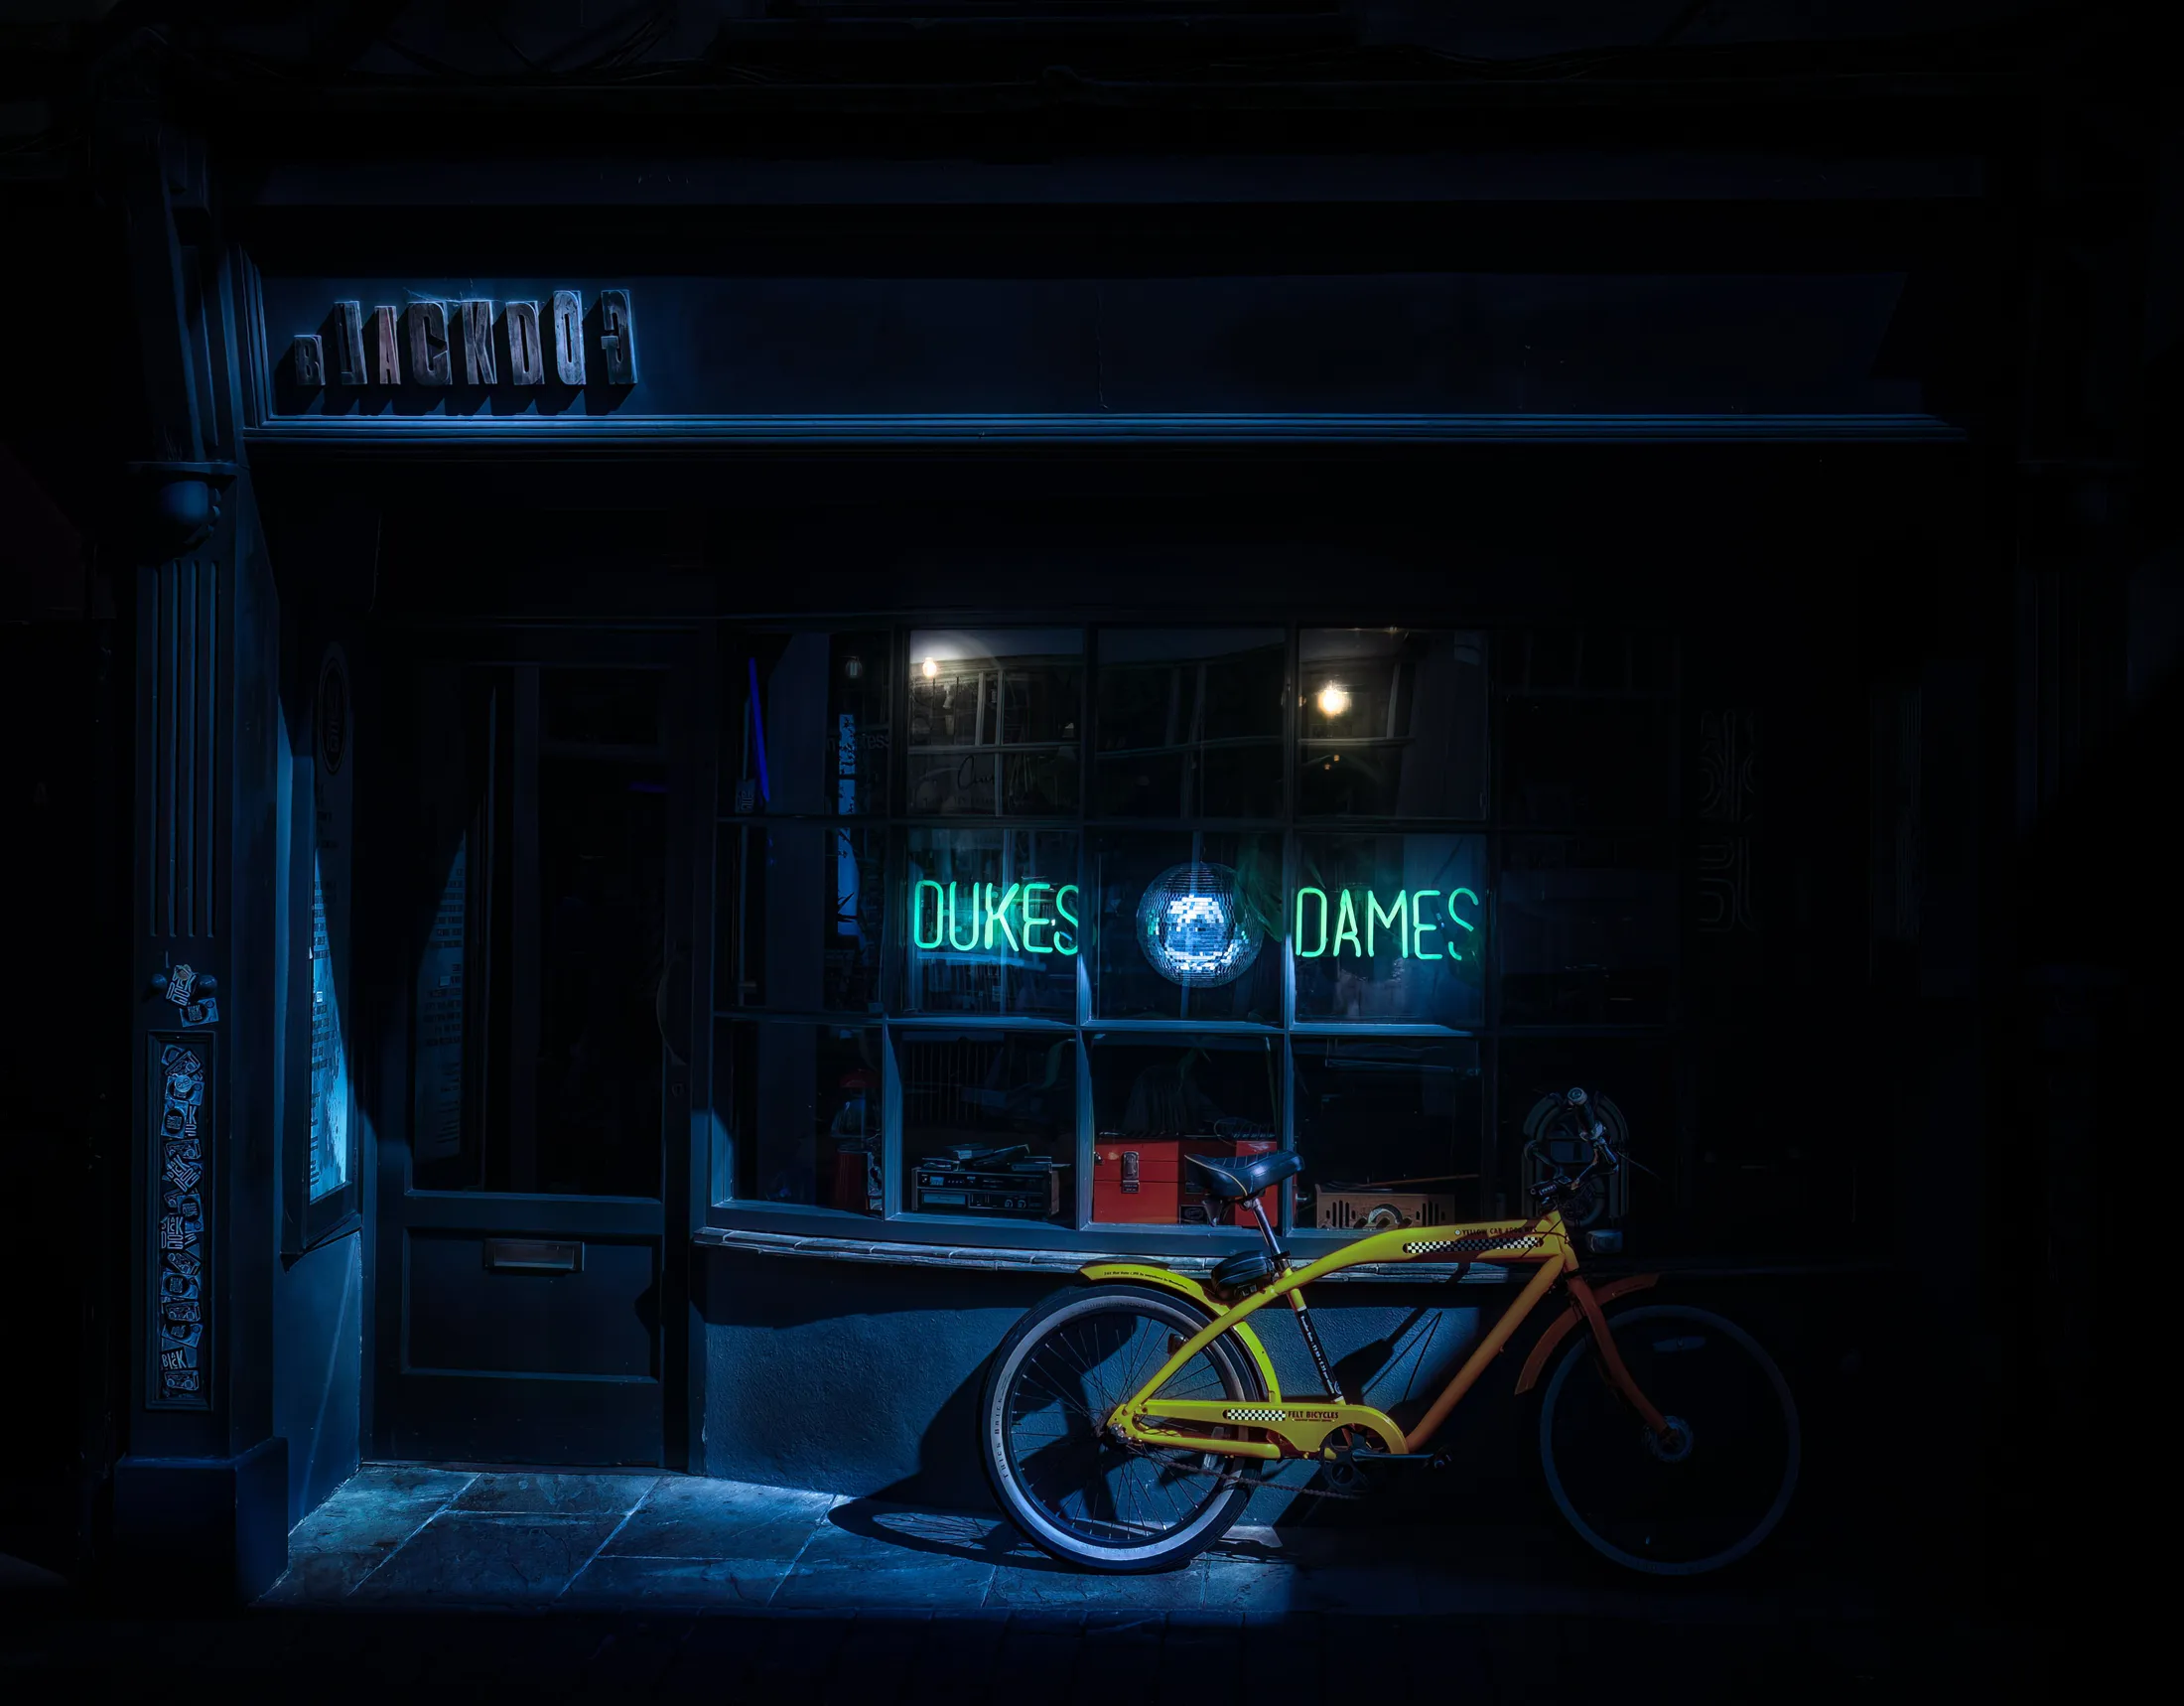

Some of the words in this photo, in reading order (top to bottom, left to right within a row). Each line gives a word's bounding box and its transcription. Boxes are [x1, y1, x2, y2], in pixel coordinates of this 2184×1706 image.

[913, 880, 1079, 955] DUKES
[1296, 887, 1479, 961] DAMES
[1288, 1410, 1303, 1419] FELT
[1305, 1411, 1339, 1420] BICYCLES
